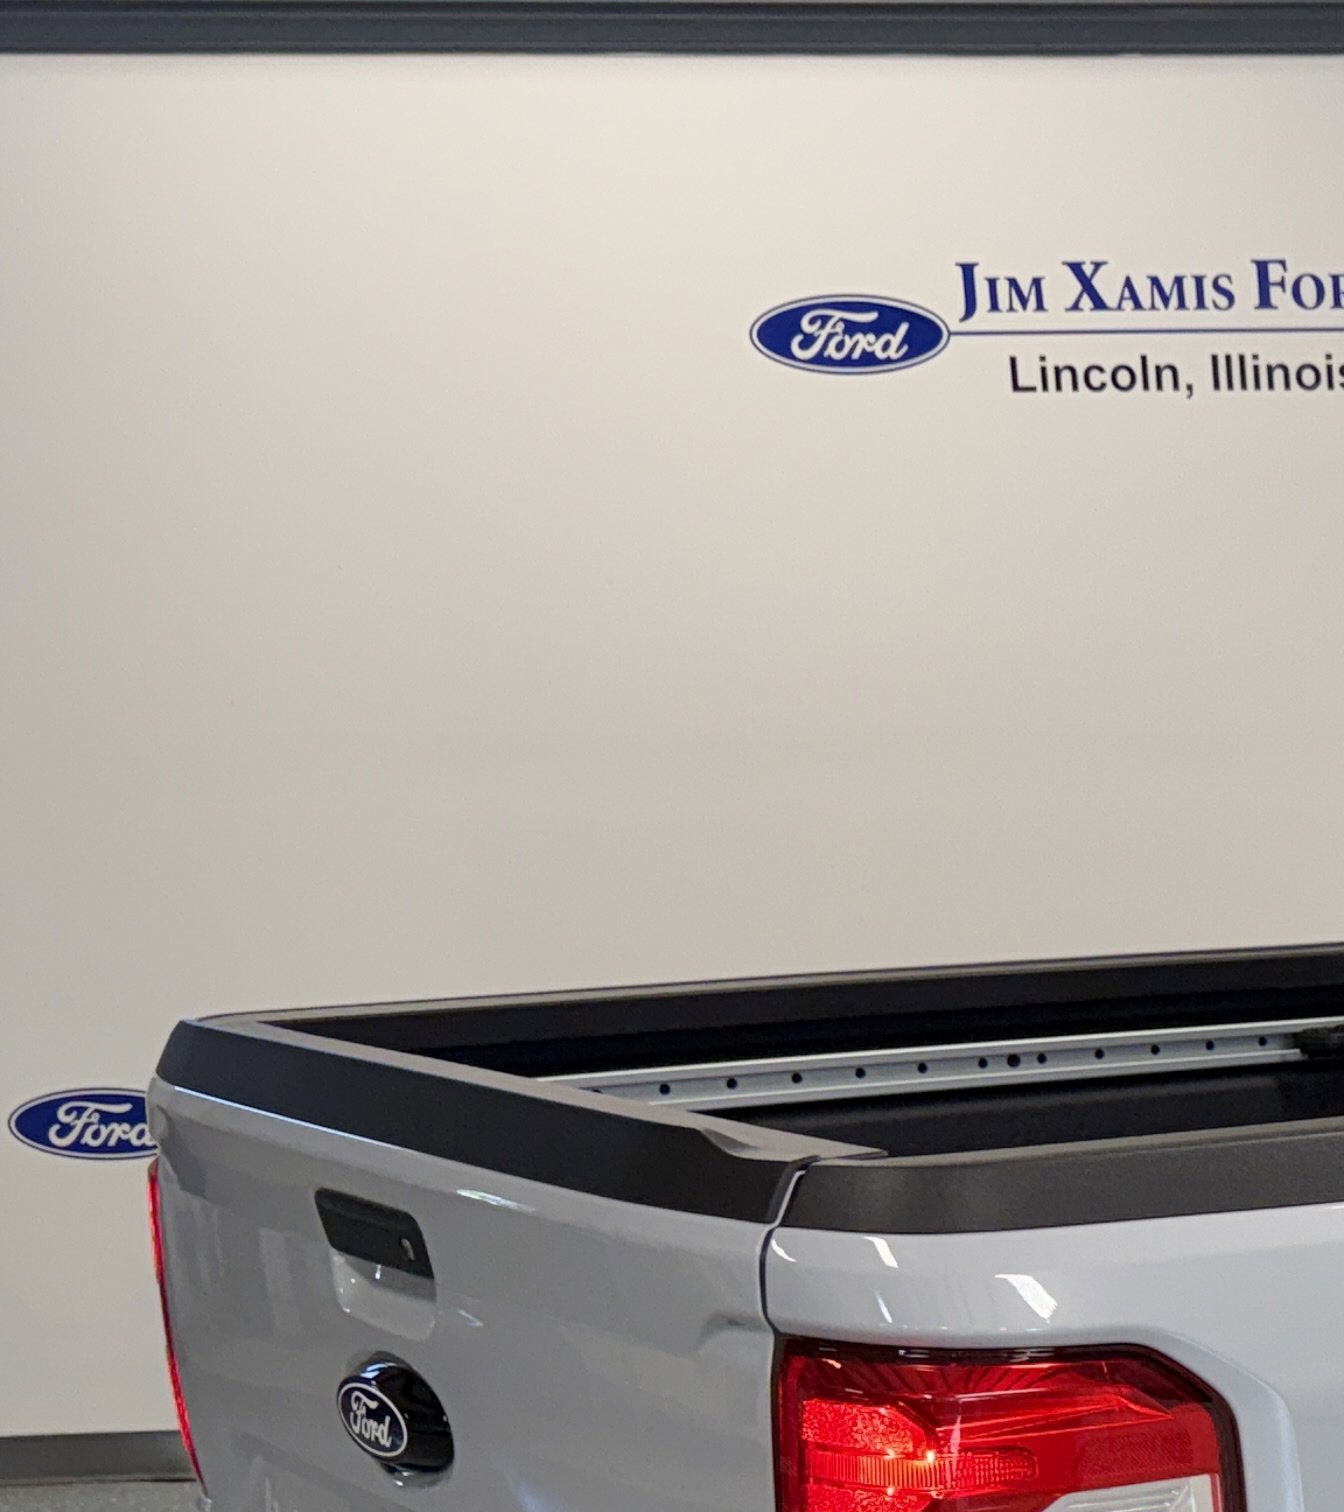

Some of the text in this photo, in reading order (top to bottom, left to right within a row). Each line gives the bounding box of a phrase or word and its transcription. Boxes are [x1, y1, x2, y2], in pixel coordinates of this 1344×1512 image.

[954, 261, 1049, 323] JIM
[1061, 260, 1236, 313] XAMIS
[790, 308, 909, 361] Ford
[1008, 353, 1194, 400] Lincoln,
[350, 1390, 392, 1448] Ford
